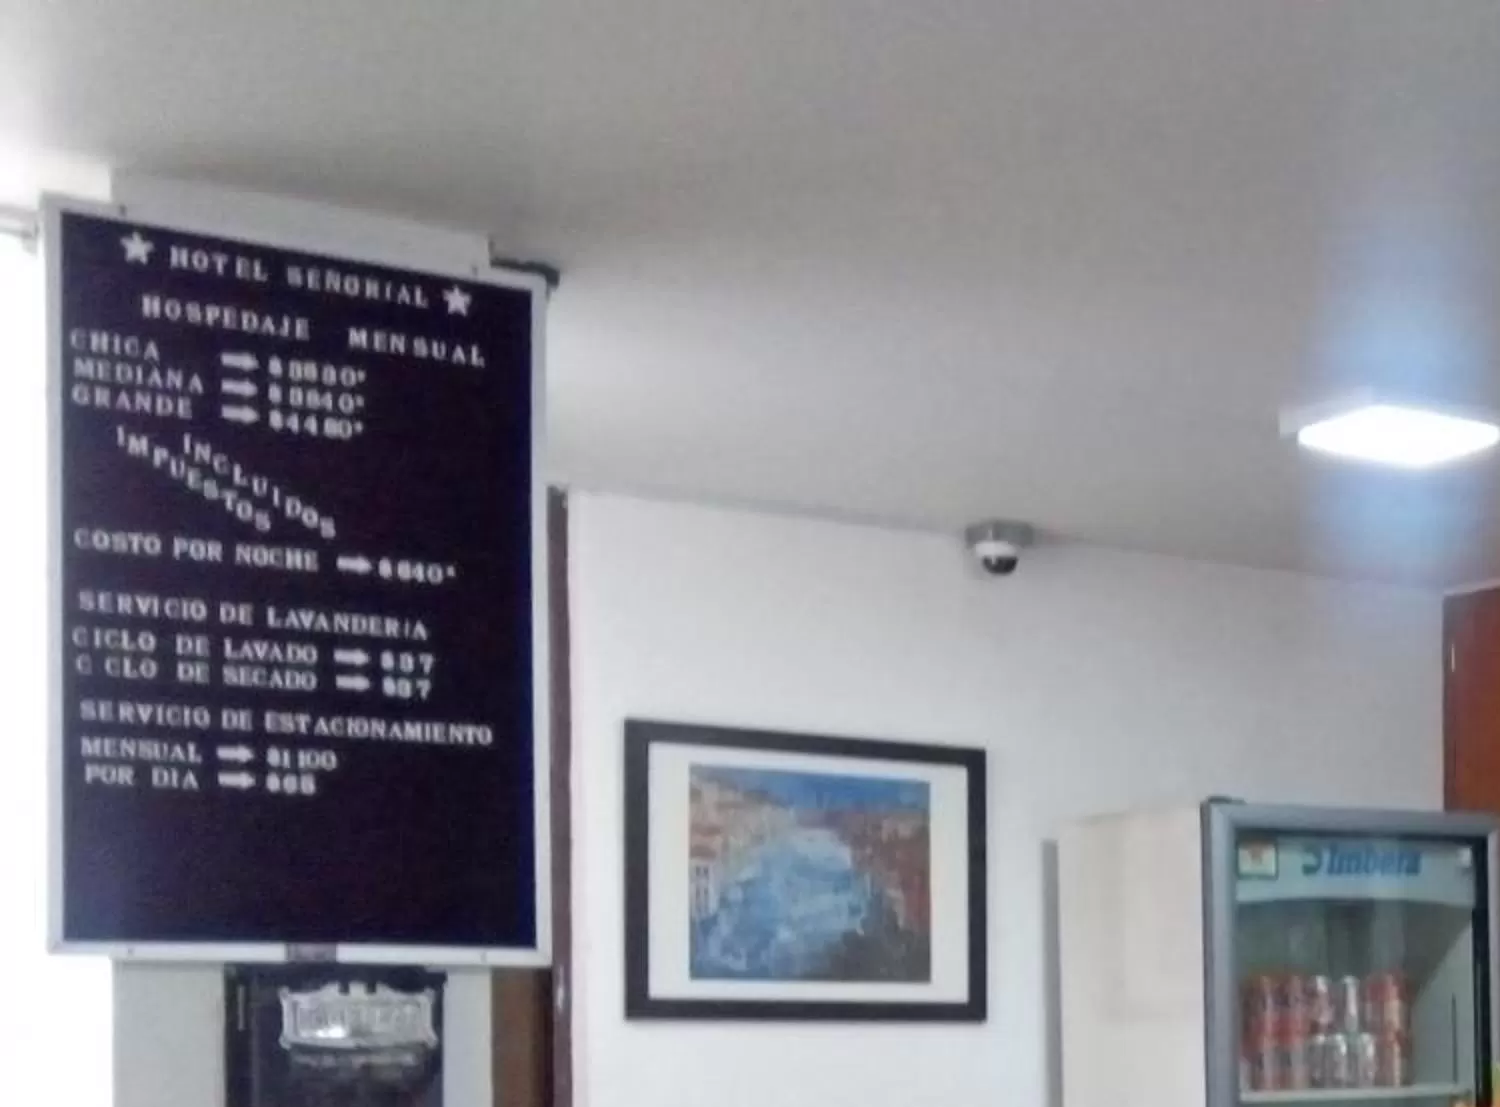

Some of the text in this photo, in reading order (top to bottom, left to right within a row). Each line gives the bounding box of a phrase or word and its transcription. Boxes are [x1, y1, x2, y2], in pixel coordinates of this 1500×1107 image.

[169, 245, 268, 283] HOTEL
[69, 327, 160, 362] CHICA
[141, 294, 487, 369] HOSPEDAJE MENSUAL
[73, 356, 204, 394] MEDIANA
[71, 383, 193, 420] GRANDE
[116, 424, 272, 533] IMPUESTOS
[183, 432, 336, 540] INCLUIDOS
[73, 528, 162, 557] COSTO
[173, 536, 223, 563] POR
[235, 544, 320, 573] NOCHE
[79, 590, 430, 641] SERVICIO DE LAVANDERIA
[72, 627, 158, 653] CICLO
[175, 632, 211, 658] DE
[223, 635, 319, 666] LAVADO
[176, 659, 211, 685] DE
[222, 662, 319, 691] SECADO
[80, 699, 494, 746] SERVICIO DE ESTACIONAMIENTO
[80, 736, 203, 764] MENSUAL
[84, 762, 134, 787] POR
[152, 766, 200, 791] DIA
